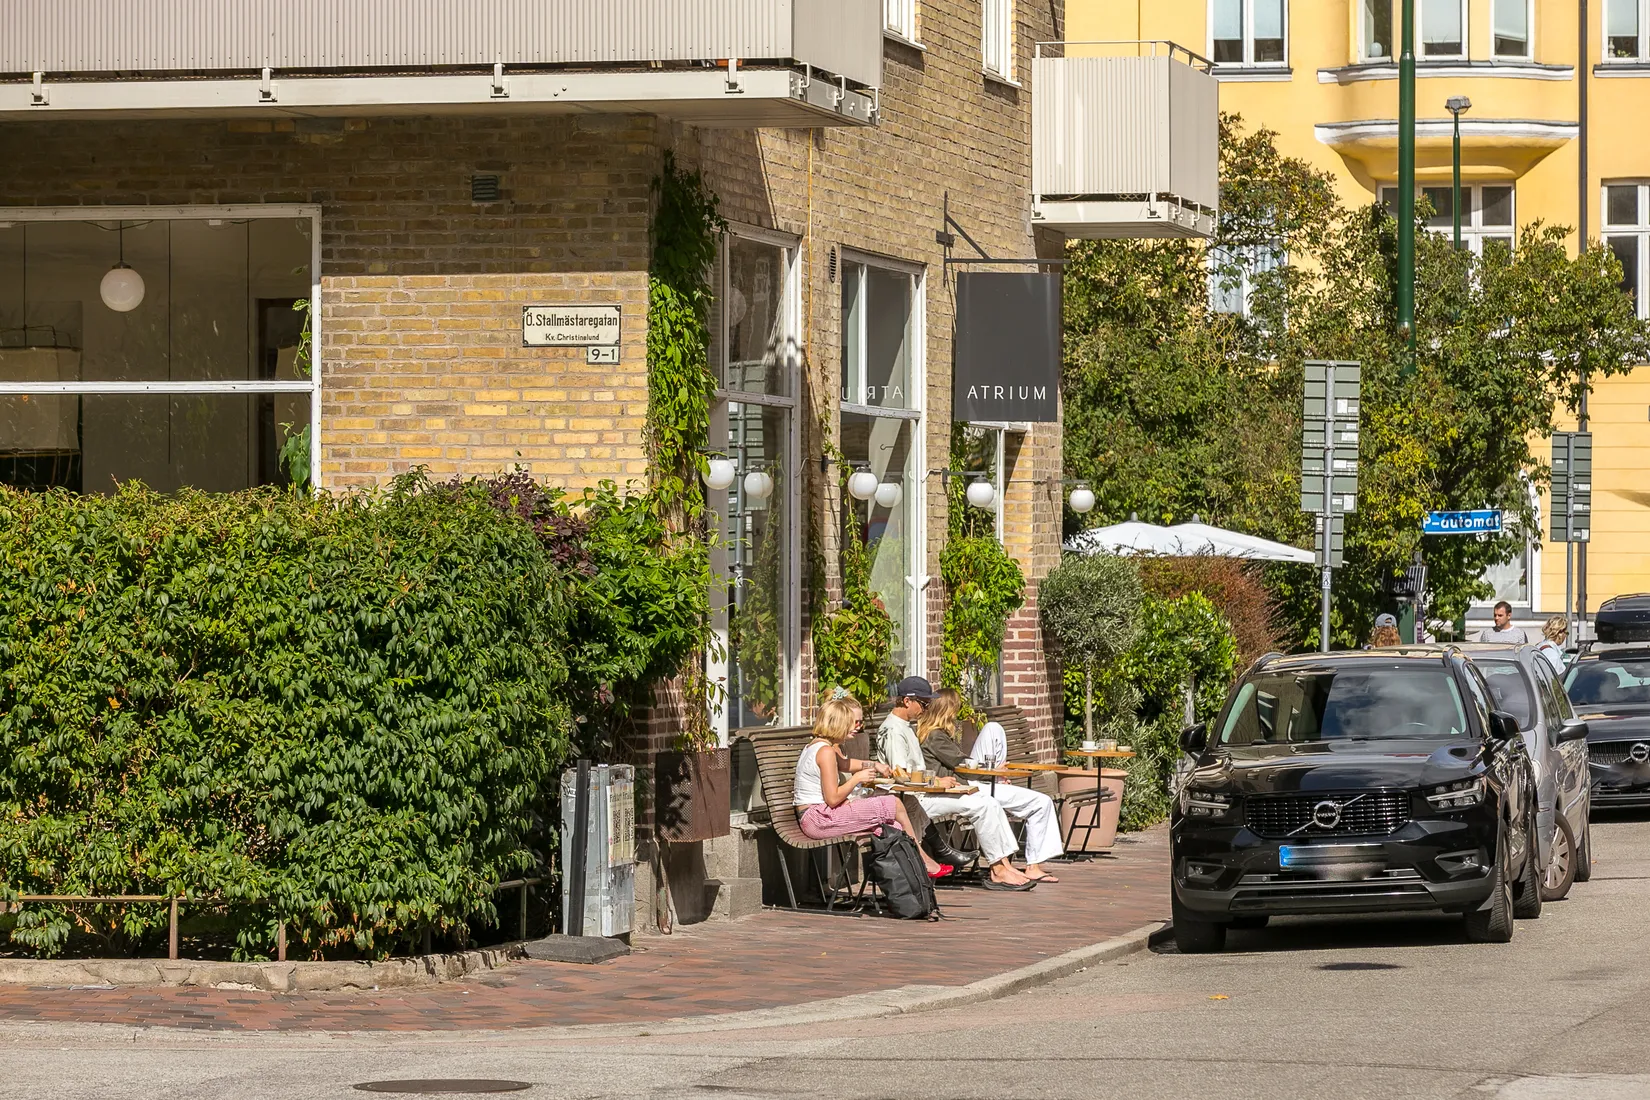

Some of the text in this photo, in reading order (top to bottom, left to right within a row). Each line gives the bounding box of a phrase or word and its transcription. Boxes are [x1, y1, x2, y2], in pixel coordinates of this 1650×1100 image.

[545, 333, 600, 341] Kv. Christinelund
[967, 385, 1046, 400] ATRIUM
[1423, 515, 1500, 528] P-automat
